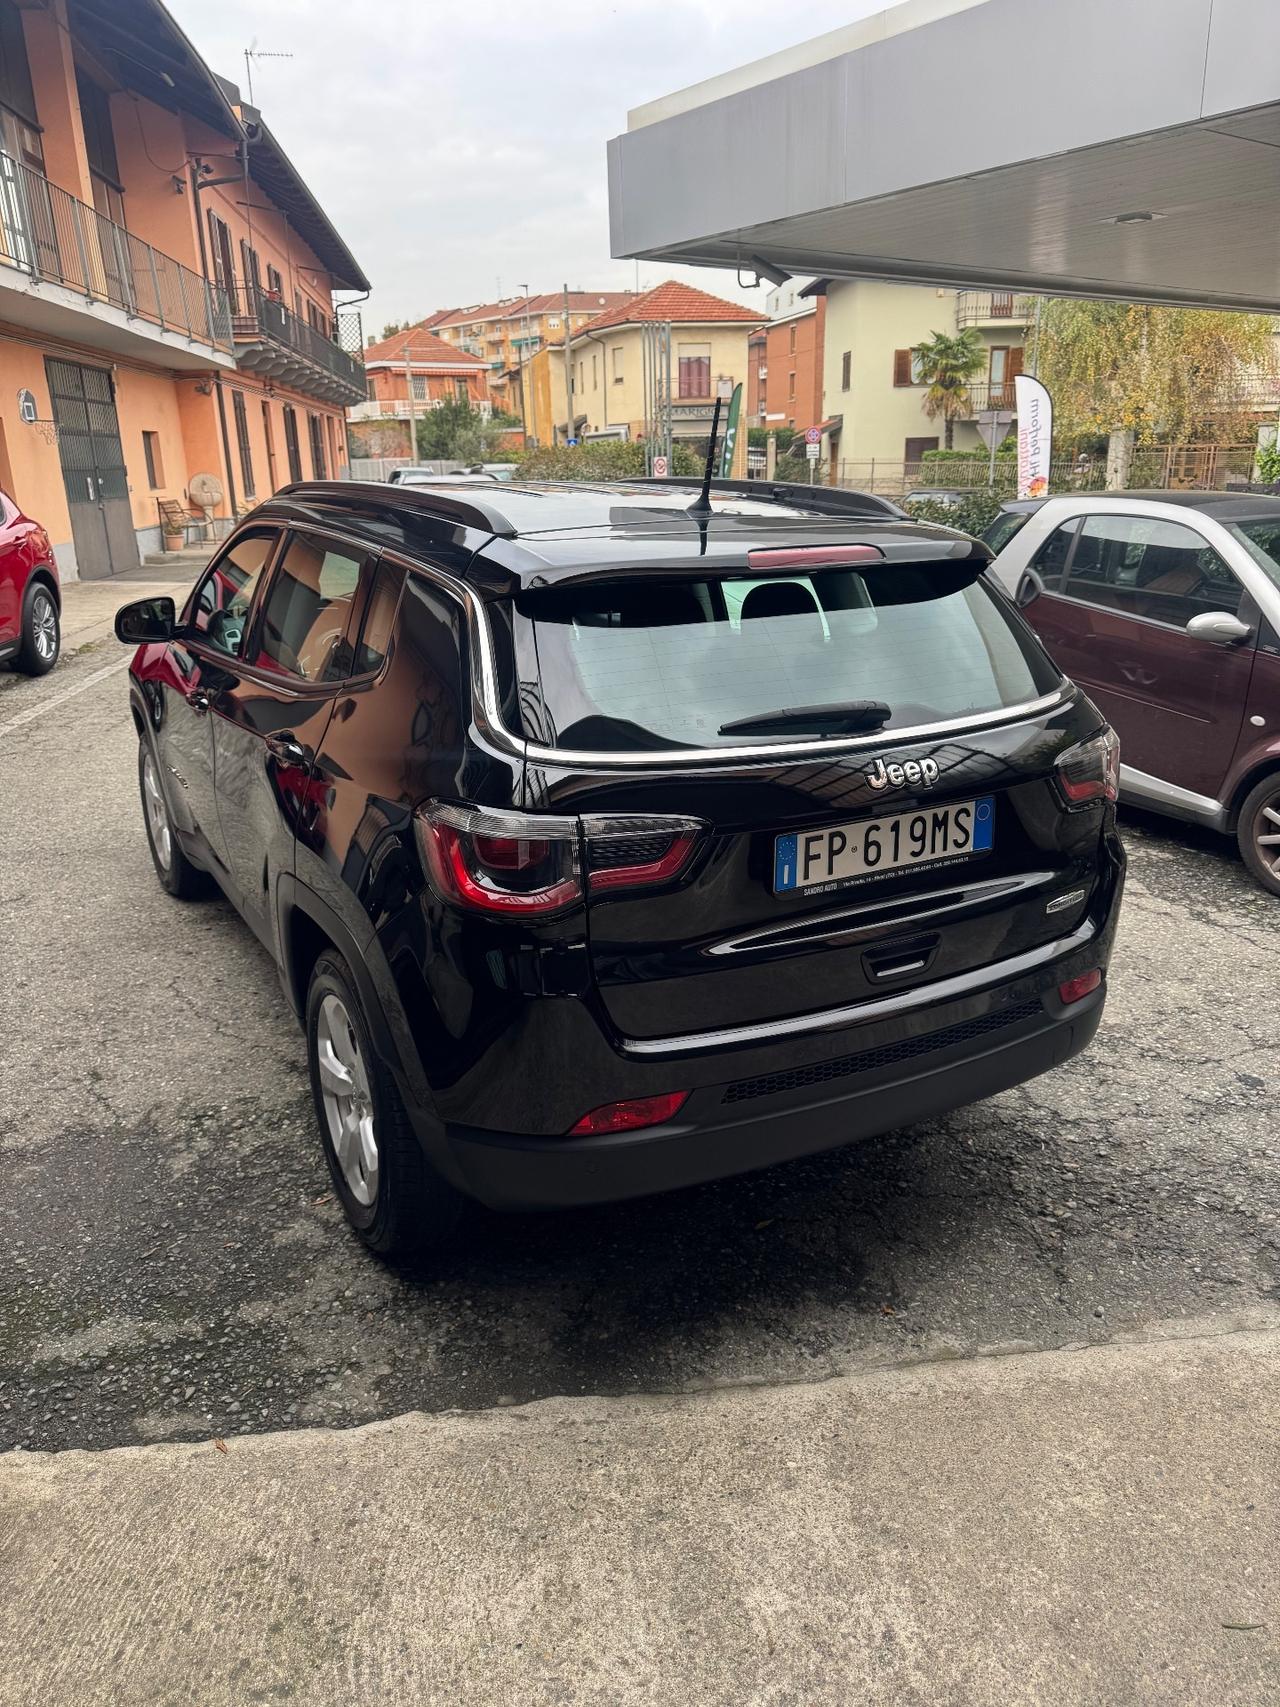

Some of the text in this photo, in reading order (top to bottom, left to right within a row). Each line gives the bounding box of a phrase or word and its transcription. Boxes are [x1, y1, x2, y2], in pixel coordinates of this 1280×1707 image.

[865, 756, 940, 791] Jeep
[863, 807, 971, 867] 619MS
[824, 882, 838, 892] AUTO
